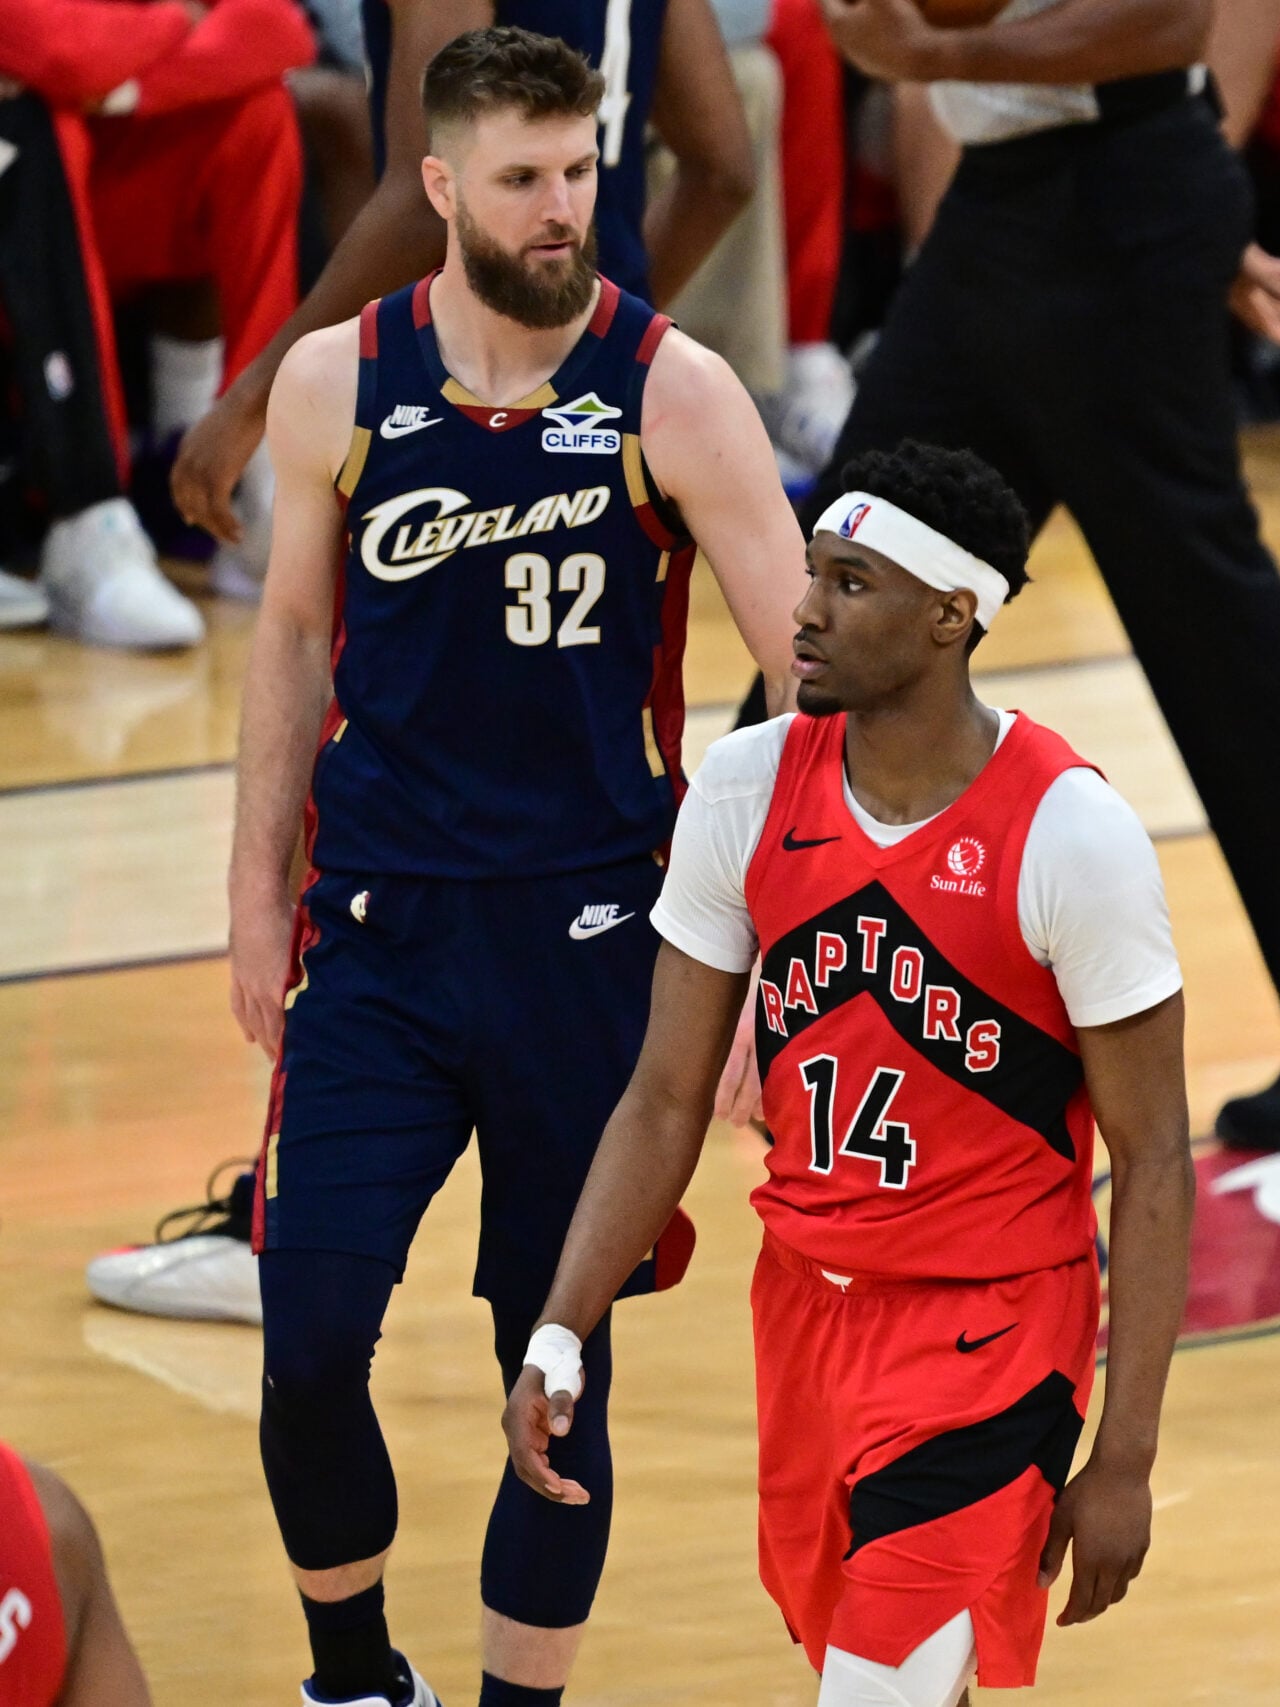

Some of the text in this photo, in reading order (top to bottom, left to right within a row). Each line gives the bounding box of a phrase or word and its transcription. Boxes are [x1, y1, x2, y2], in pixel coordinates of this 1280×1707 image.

[392, 404, 430, 426] NIKE
[488, 413, 509, 428] C
[545, 432, 618, 449] CLIFFS
[360, 485, 611, 583] CLEVELAND
[504, 552, 607, 648] 32
[930, 874, 987, 898] Sun Life
[578, 904, 620, 927] NIKE
[759, 915, 1002, 1073] RAPTORS
[798, 1052, 917, 1191] 14
